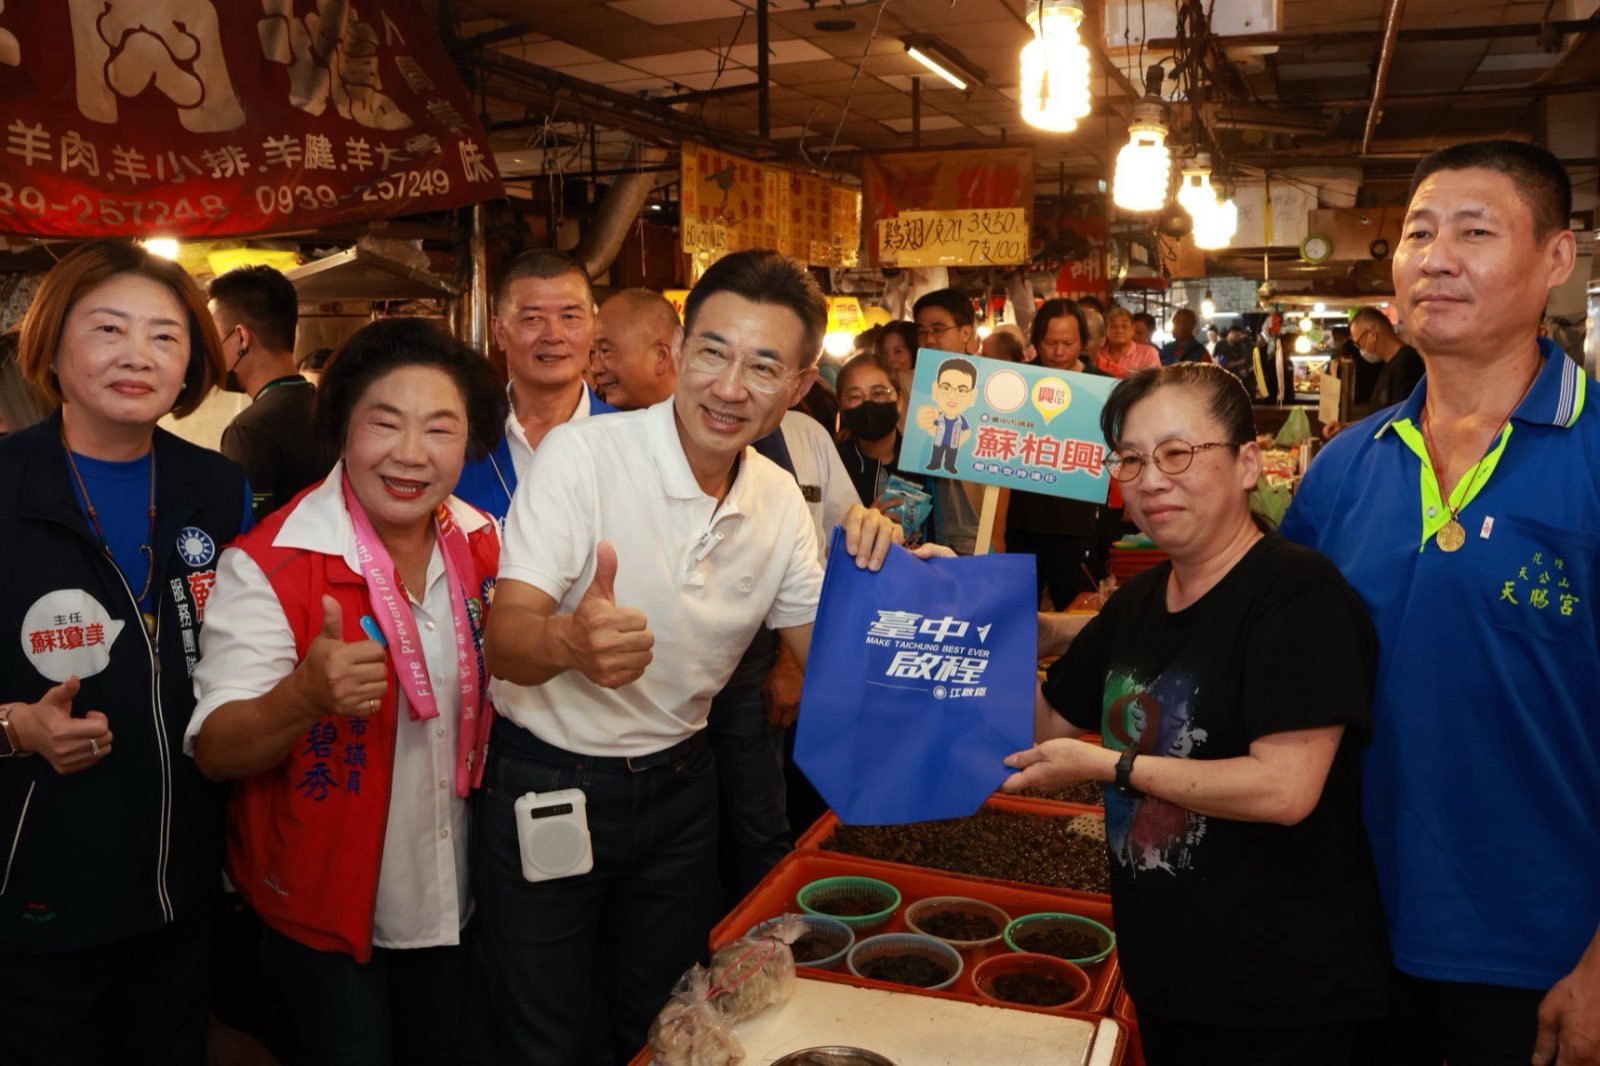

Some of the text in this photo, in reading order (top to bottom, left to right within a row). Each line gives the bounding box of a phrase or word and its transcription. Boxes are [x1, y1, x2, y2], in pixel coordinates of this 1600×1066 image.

[974, 427, 1104, 476] 蘇柏興
[1518, 566, 1570, 588] 天公山
[53, 611, 83, 626] 主任
[369, 567, 416, 655] Prevention
[867, 609, 970, 643] 臺中
[865, 636, 991, 658] MAKE TAICHUNG BEST EVER
[409, 660, 431, 698] Fire
[295, 719, 340, 801] 碧秀
[343, 715, 369, 796] 市議員
